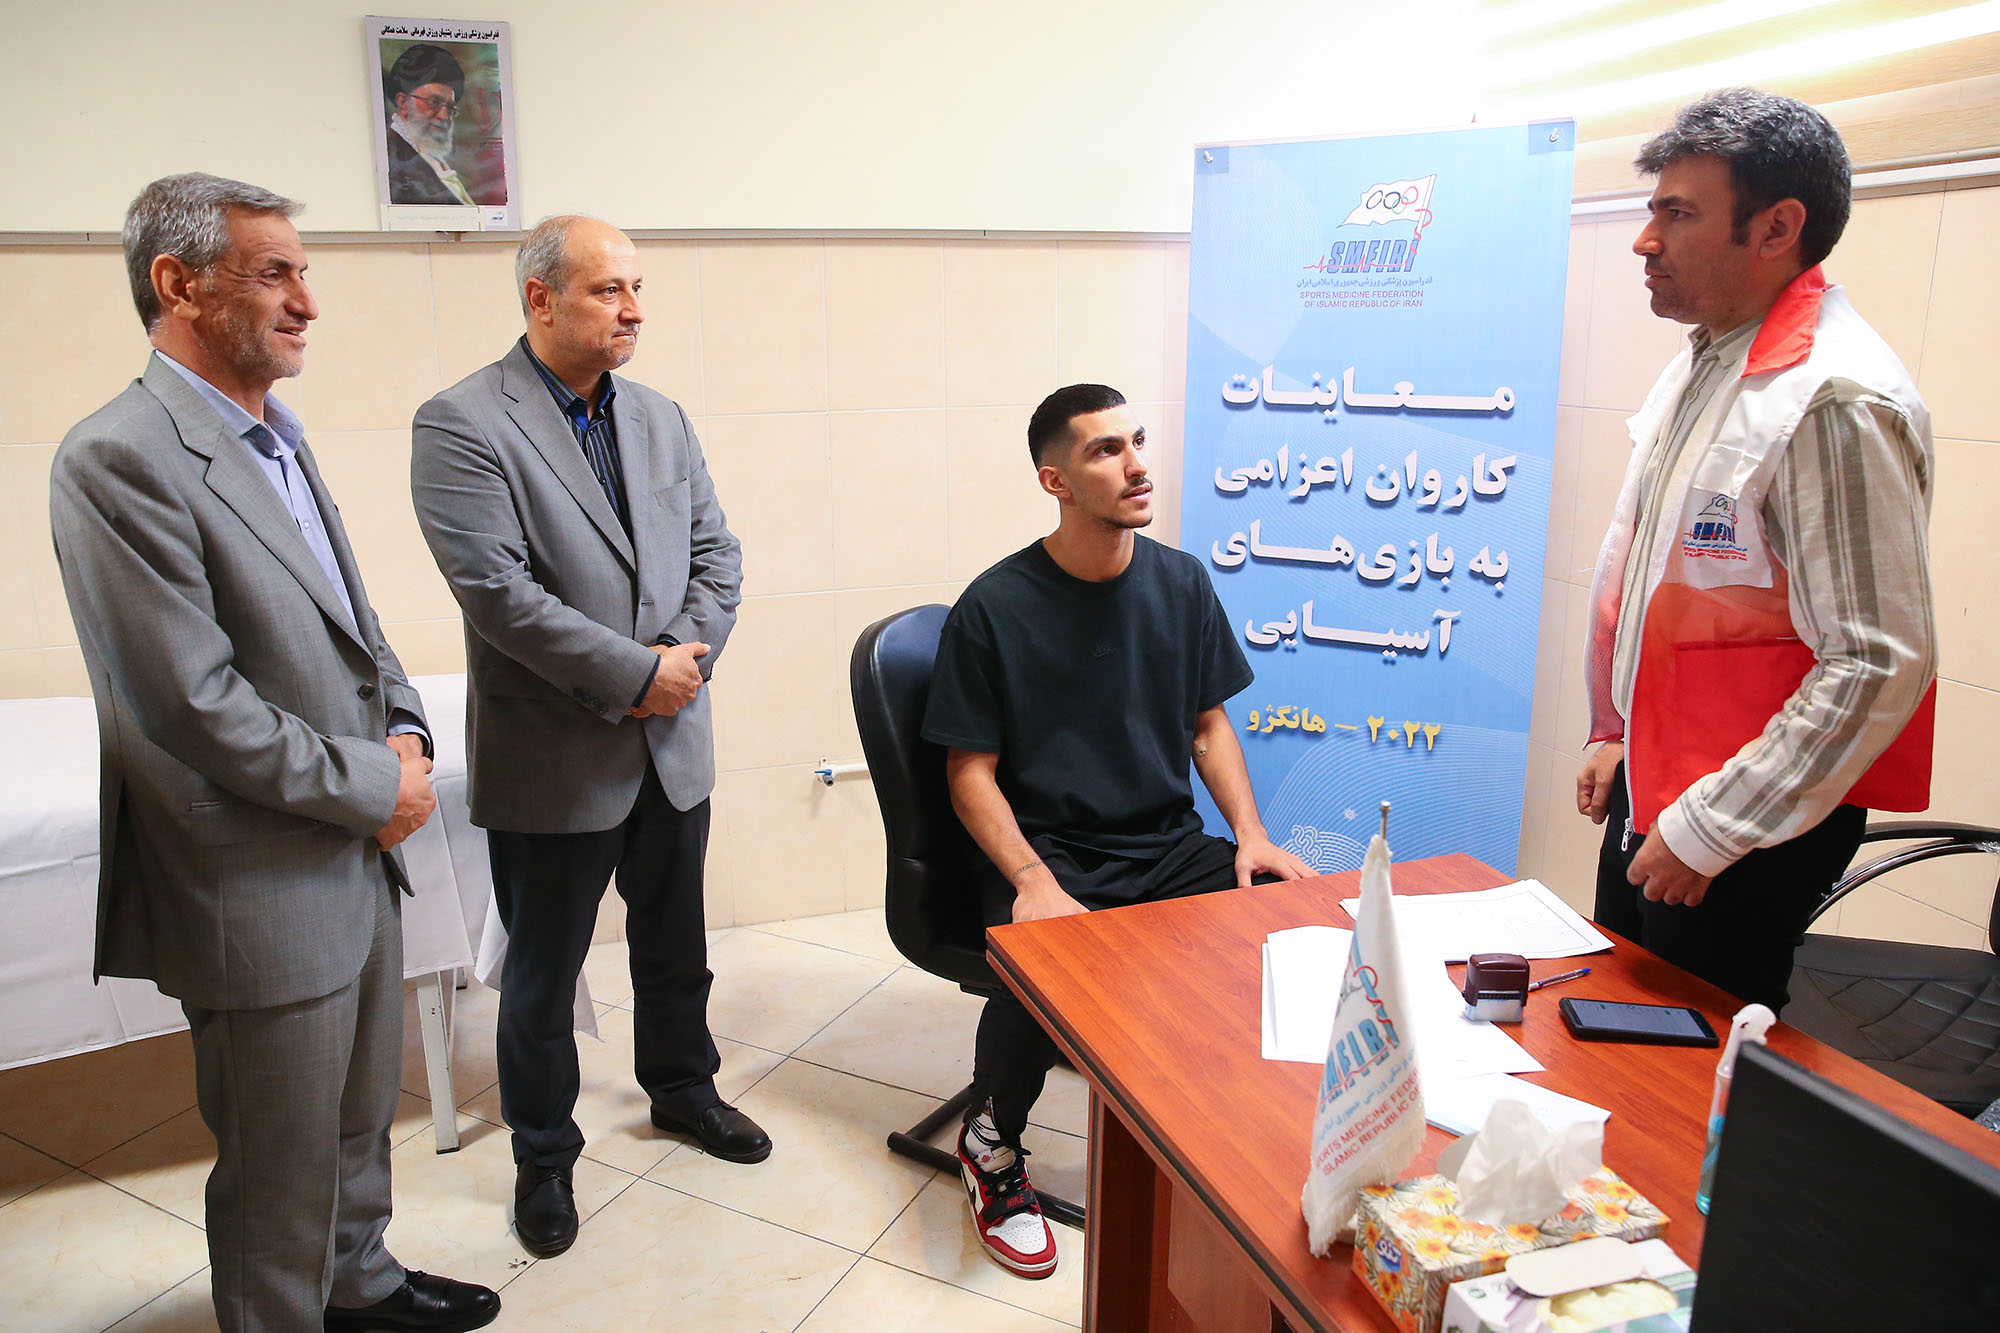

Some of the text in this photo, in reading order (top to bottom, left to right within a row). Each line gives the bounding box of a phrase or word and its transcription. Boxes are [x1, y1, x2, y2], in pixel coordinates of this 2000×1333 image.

[1326, 239, 1419, 274] SMFIRI
[1300, 290, 1424, 299] SPORTS MEDICINE FEDERATION
[1304, 299, 1423, 308] OF ISLAMIC REPUBLIC OF IRAN
[1221, 364, 1516, 418] معاینات
[1214, 443, 1517, 507] کاروان اعزامی
[1468, 545, 1510, 591] به
[1244, 600, 1462, 658] آسیایی
[1245, 703, 1327, 734] هانگژو
[1320, 1004, 1400, 1113] MFIRI
[1340, 1101, 1392, 1144] MEDICINE
[1359, 1099, 1410, 1146] REPUBLIC
[1006, 1193, 1025, 1209] NIKE
